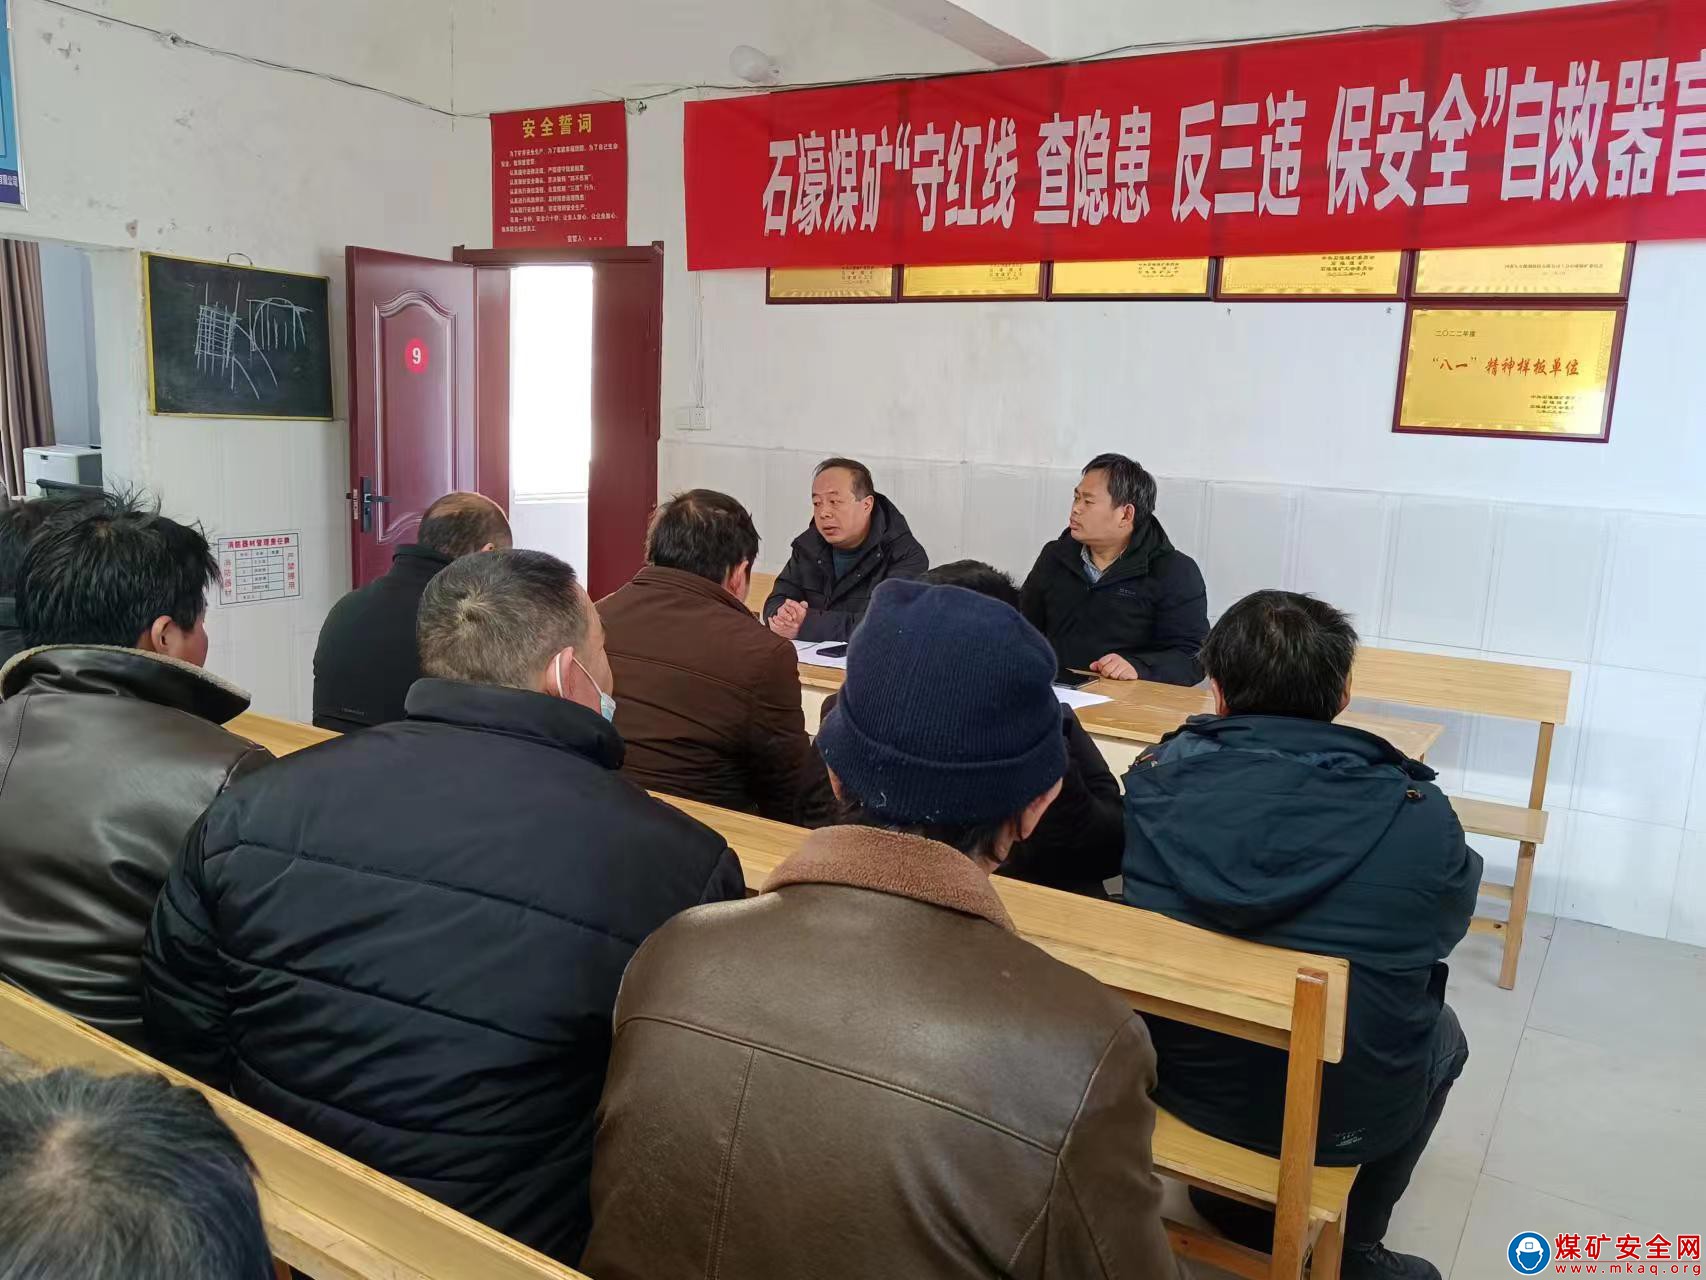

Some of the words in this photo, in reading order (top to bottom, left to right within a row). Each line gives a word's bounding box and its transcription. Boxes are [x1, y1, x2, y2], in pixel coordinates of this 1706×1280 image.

[522, 113, 592, 138] 安全誓词
[1033, 105, 1151, 227] 查隐患
[1171, 91, 1307, 222] 反三违
[412, 347, 422, 365] 9
